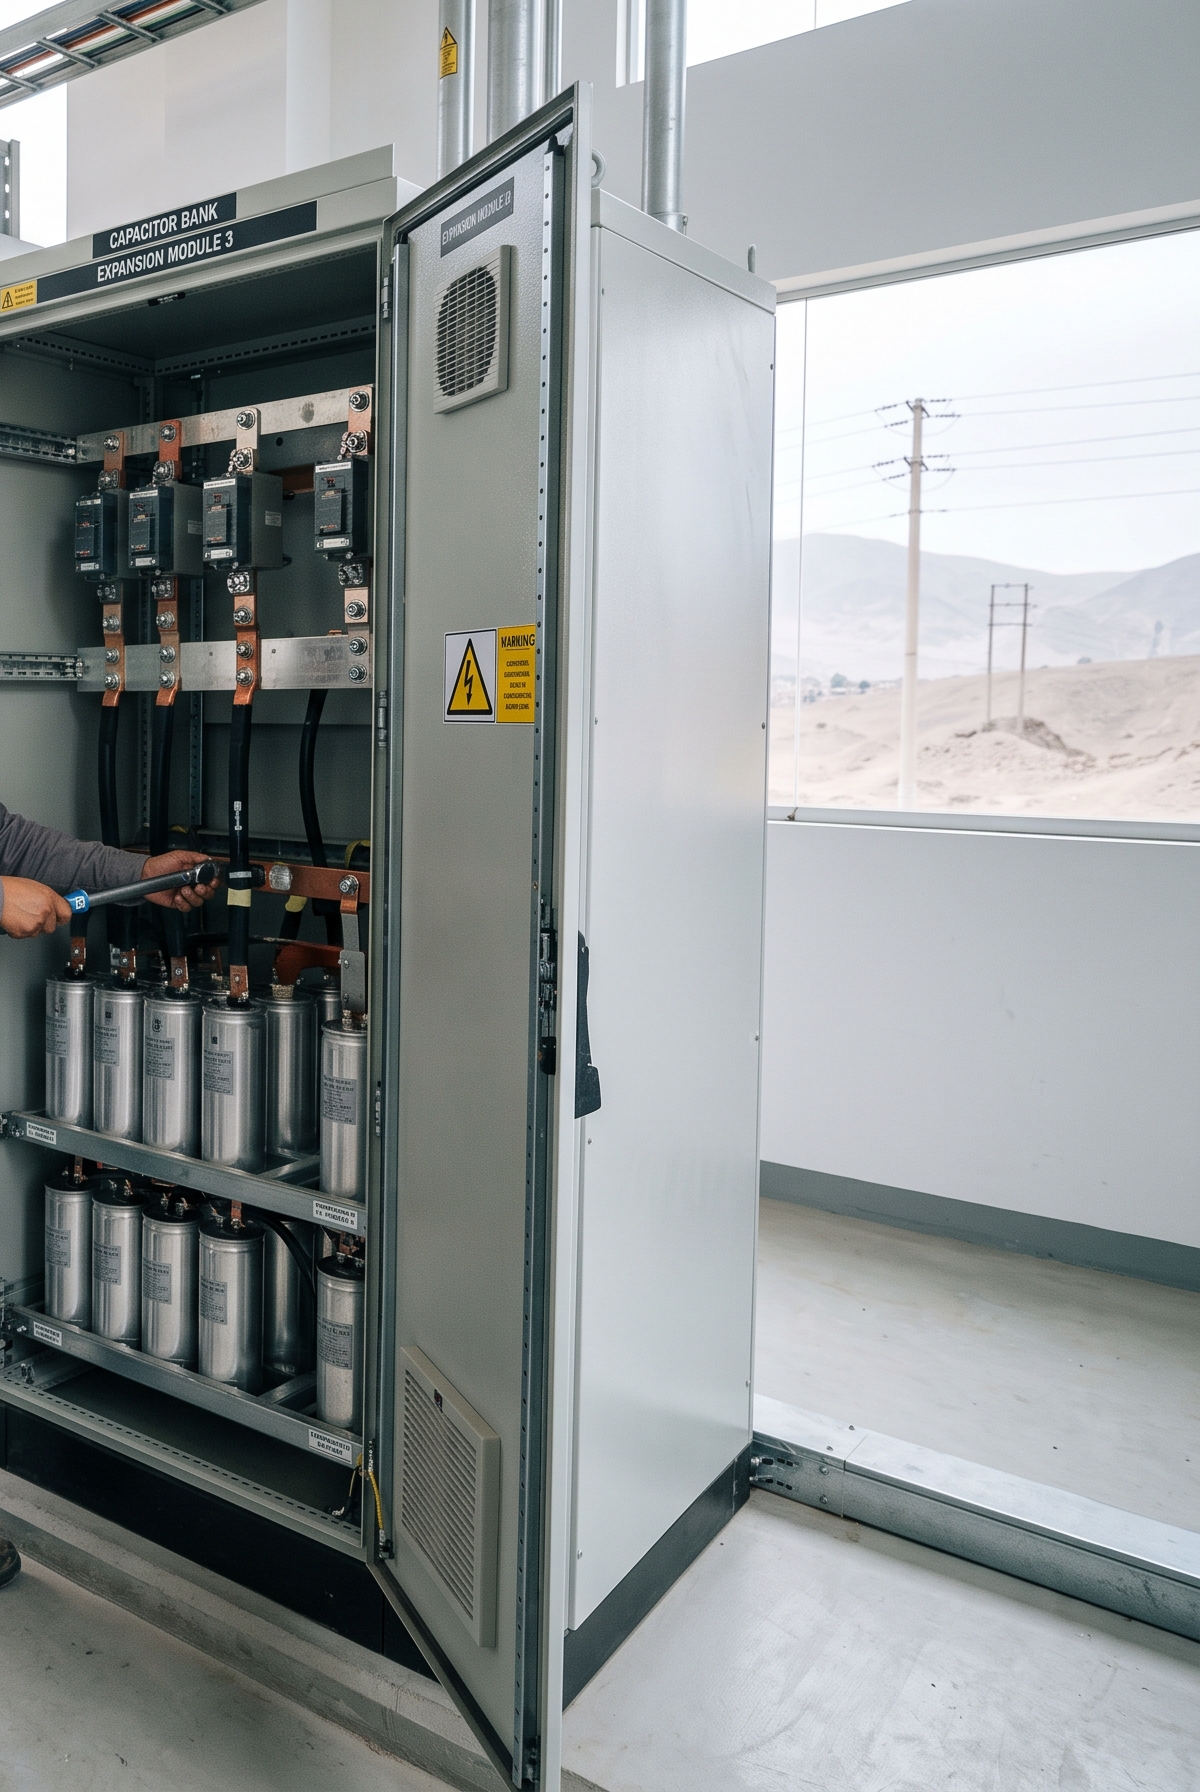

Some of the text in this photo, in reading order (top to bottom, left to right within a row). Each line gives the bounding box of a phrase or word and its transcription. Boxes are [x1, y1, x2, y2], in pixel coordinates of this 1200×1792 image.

[109, 202, 218, 249] CAPACITOR BANK
[97, 230, 234, 283] EXPANSION MODULE 3
